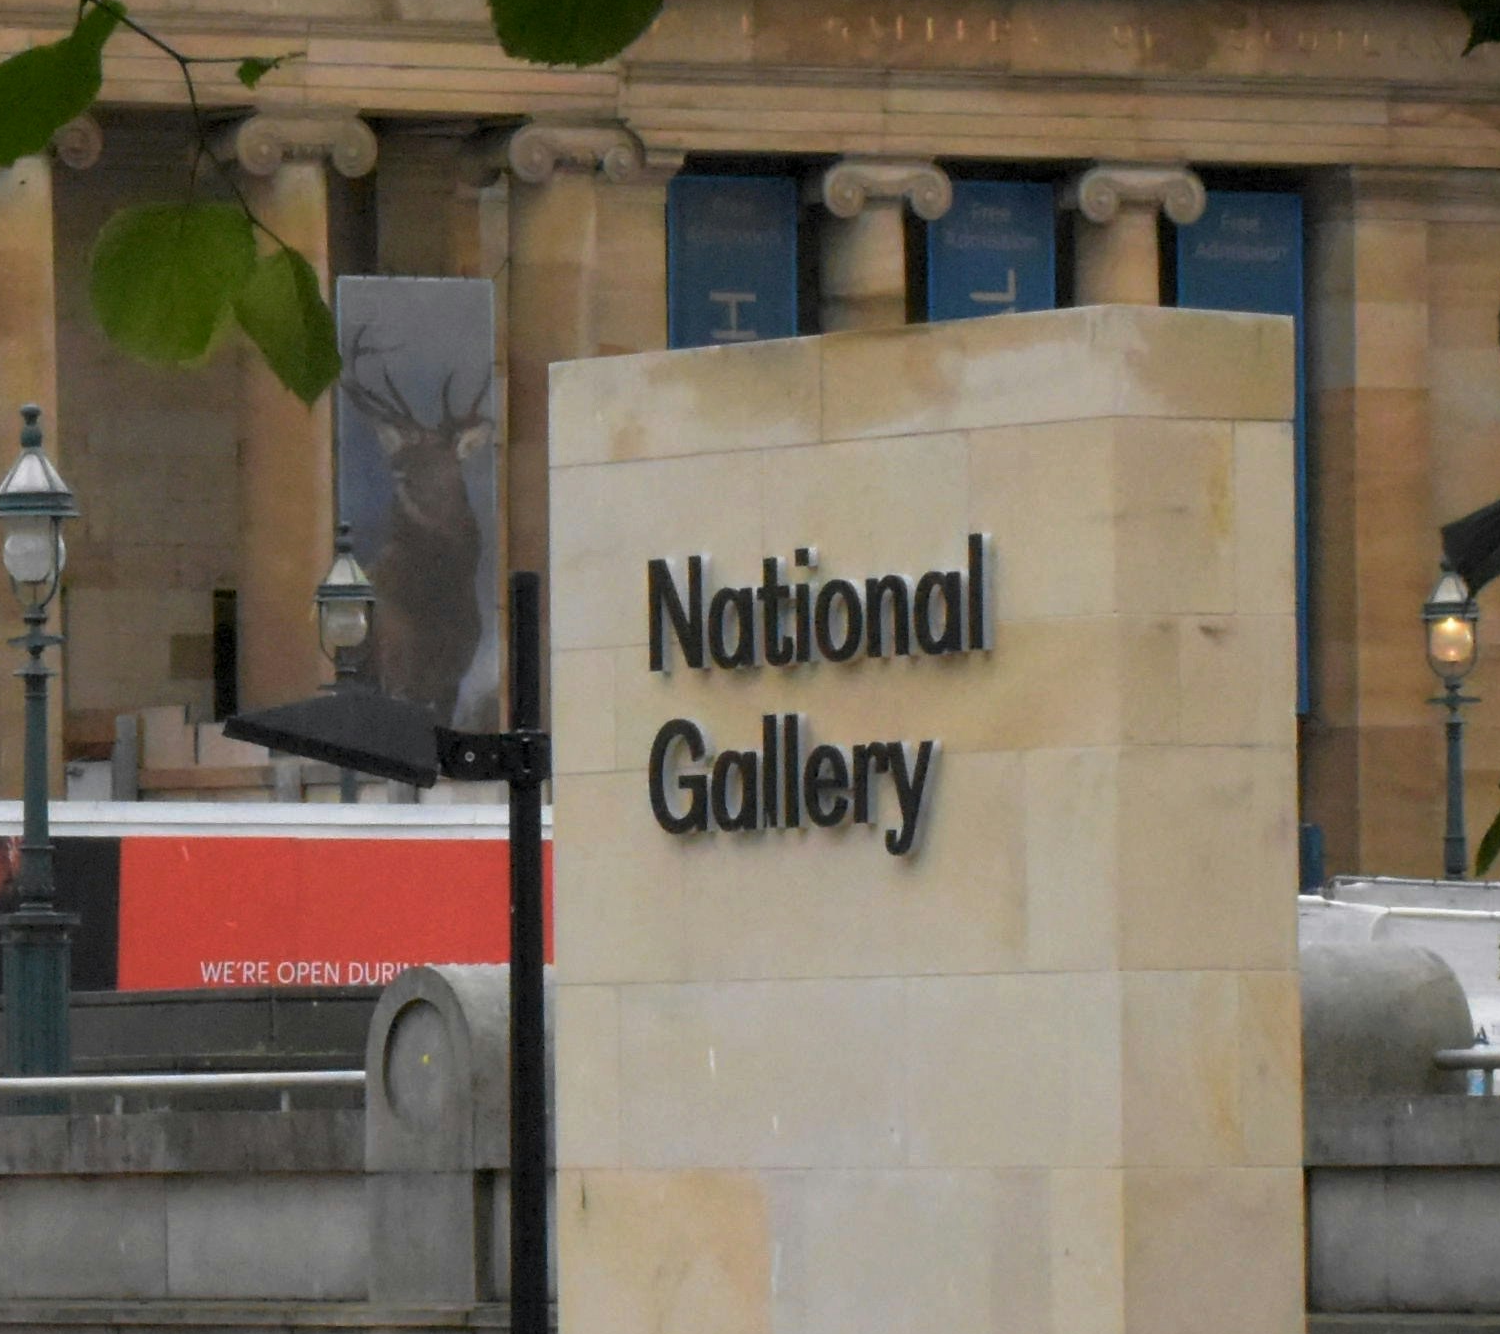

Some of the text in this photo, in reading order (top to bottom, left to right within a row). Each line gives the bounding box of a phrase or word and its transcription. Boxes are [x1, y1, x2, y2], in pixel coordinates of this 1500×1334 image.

[647, 532, 988, 672] National
[648, 712, 938, 857] Gallery
[200, 961, 270, 985] WE'RE
[276, 961, 341, 985] OPEN
